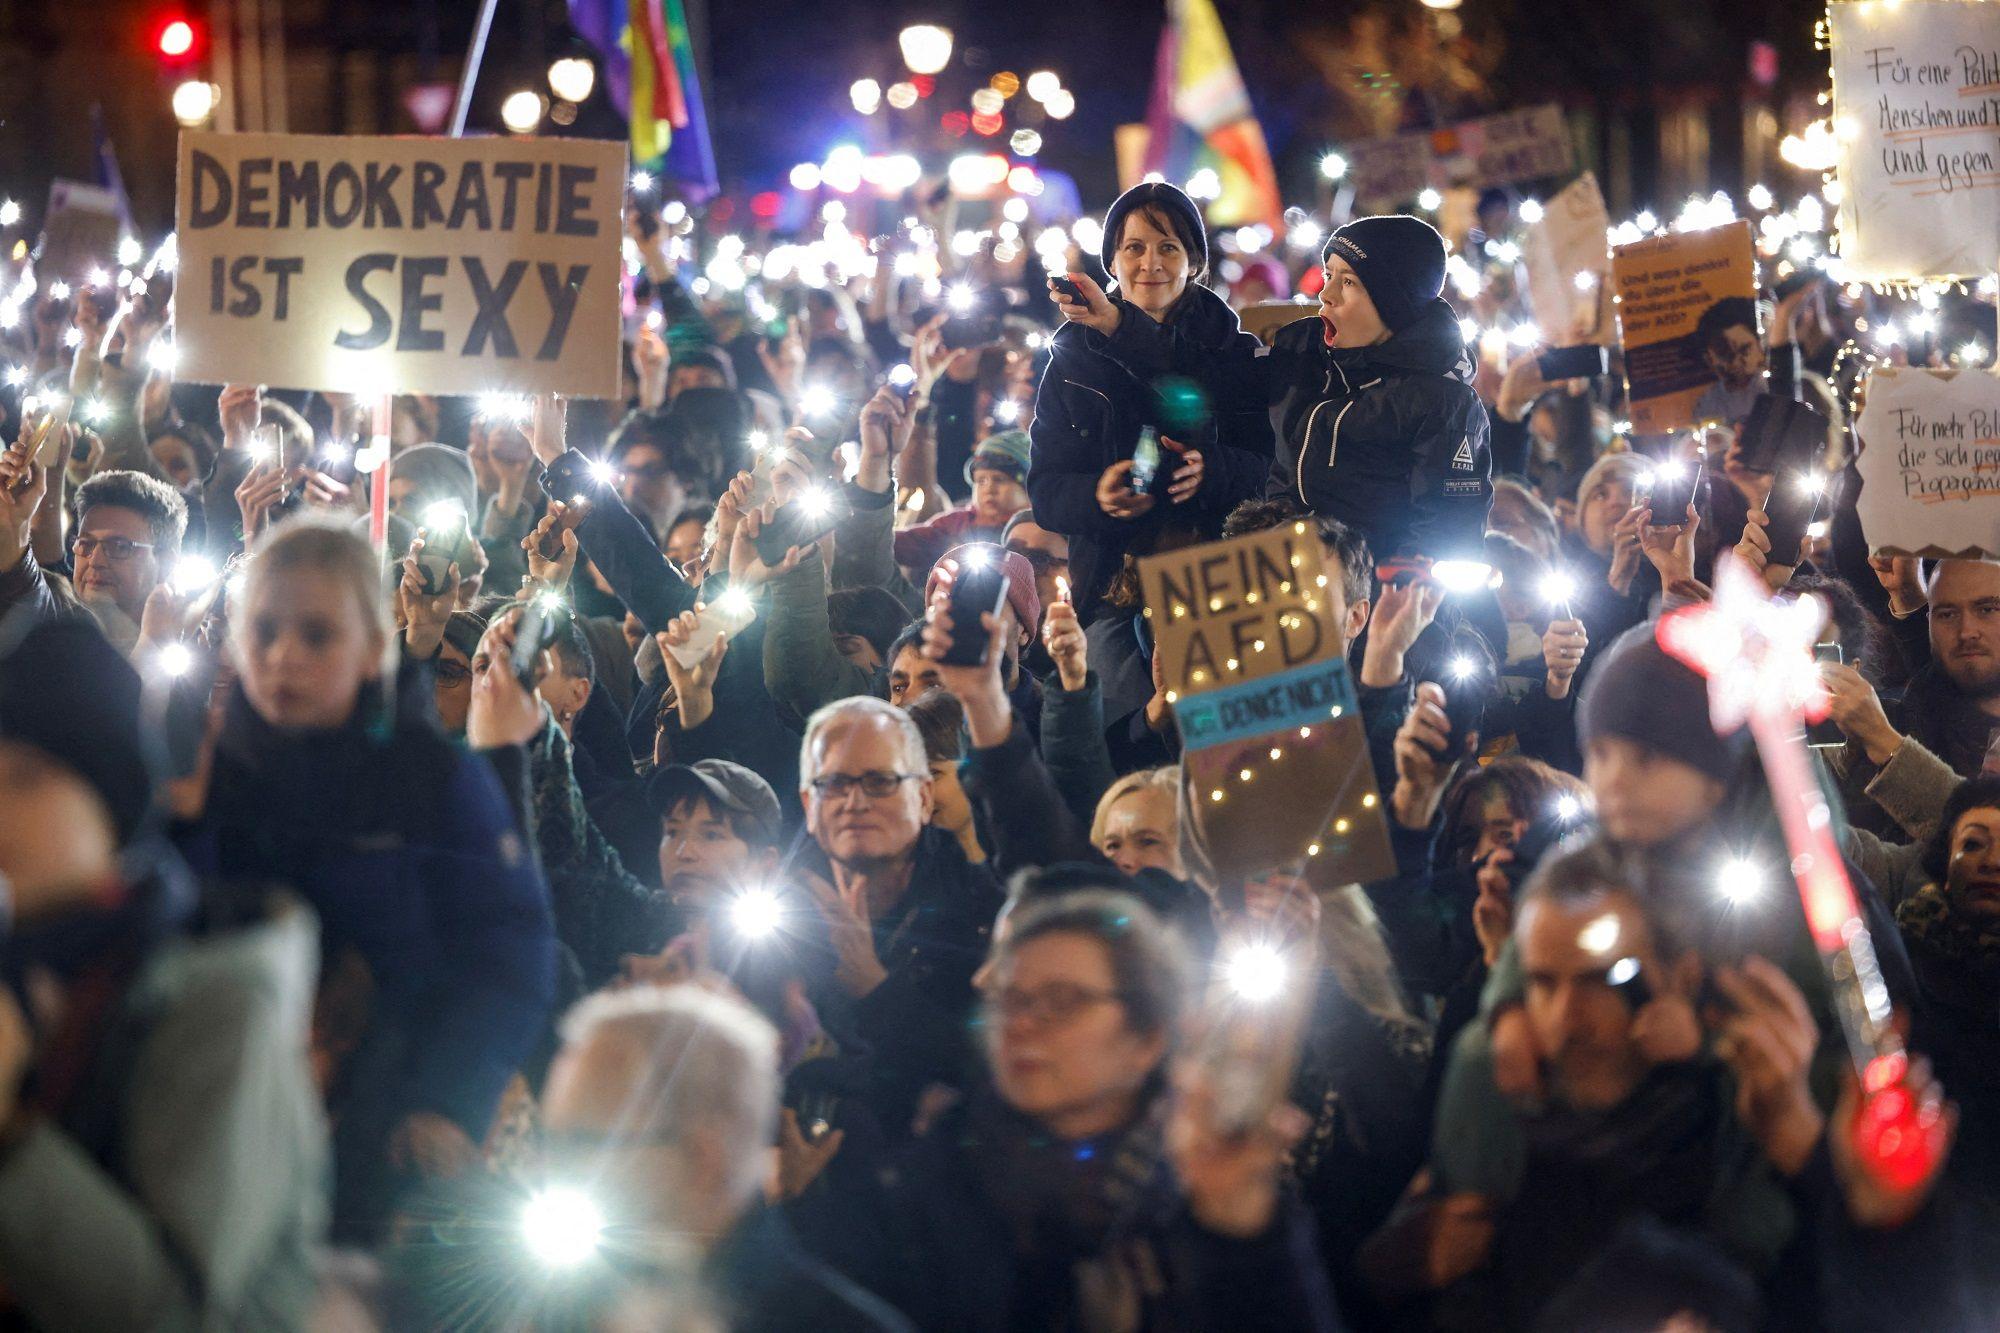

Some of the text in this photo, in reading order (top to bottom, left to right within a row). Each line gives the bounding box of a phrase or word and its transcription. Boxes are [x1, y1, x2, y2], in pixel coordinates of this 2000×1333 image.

[1864, 46, 1911, 85] Für
[1918, 60, 1951, 86] eine
[1879, 94, 1954, 131] Menschen
[1957, 99, 1988, 128] und
[1937, 150, 1993, 193] gegen
[189, 149, 600, 238] DEMOKRATIE
[208, 252, 591, 362] IST SEXY
[1888, 408, 2000, 440] Für mehr Pol
[1898, 443, 1926, 469] die
[1935, 443, 1968, 468] sich
[1160, 539, 1301, 625] NEIN
[1181, 604, 1322, 690] AFD
